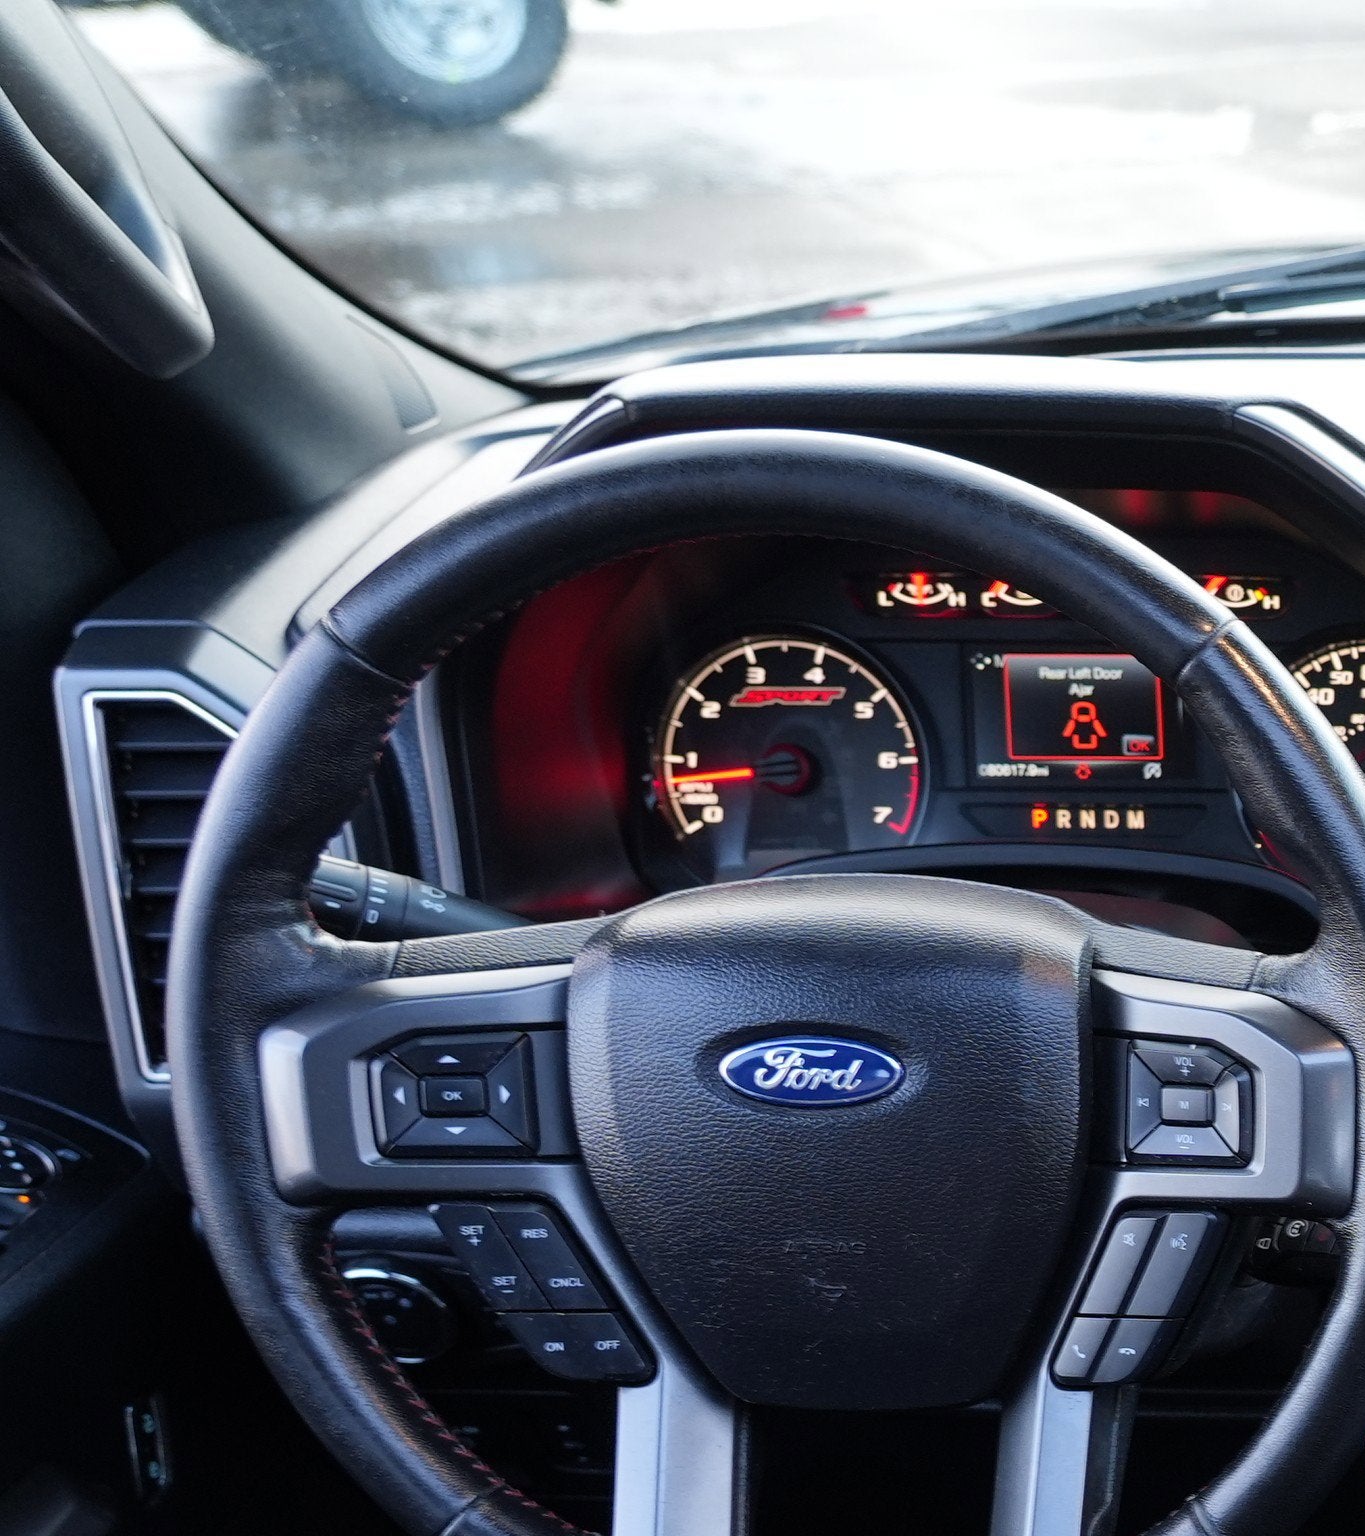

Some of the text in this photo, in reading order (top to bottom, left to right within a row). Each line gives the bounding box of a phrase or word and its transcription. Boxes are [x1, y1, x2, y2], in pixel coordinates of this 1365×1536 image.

[746, 667, 766, 684] 3
[803, 667, 826, 684] 4
[1038, 666, 1123, 680] Rear Left Door
[1329, 671, 1353, 685] 50
[1068, 683, 1094, 697] Ajar
[1309, 688, 1335, 705] 40
[700, 701, 721, 719] 2
[854, 701, 874, 719] 5
[1129, 740, 1150, 752] OK
[686, 752, 698, 768] 1
[877, 752, 899, 768] 6
[702, 805, 724, 823] 0
[872, 806, 893, 823] 7
[1031, 809, 1145, 829] P R N D M
[754, 1047, 864, 1090] Ford
[1173, 1056, 1195, 1067] VOL
[442, 1091, 463, 1102] OK
[1179, 1101, 1189, 1110] M
[1175, 1134, 1195, 1144] VOL
[460, 1224, 484, 1235] SET
[521, 1228, 548, 1239] RES
[492, 1276, 516, 1287] SET
[549, 1276, 584, 1288] CNCL
[544, 1341, 565, 1352] ON
[594, 1340, 620, 1351] OFF
